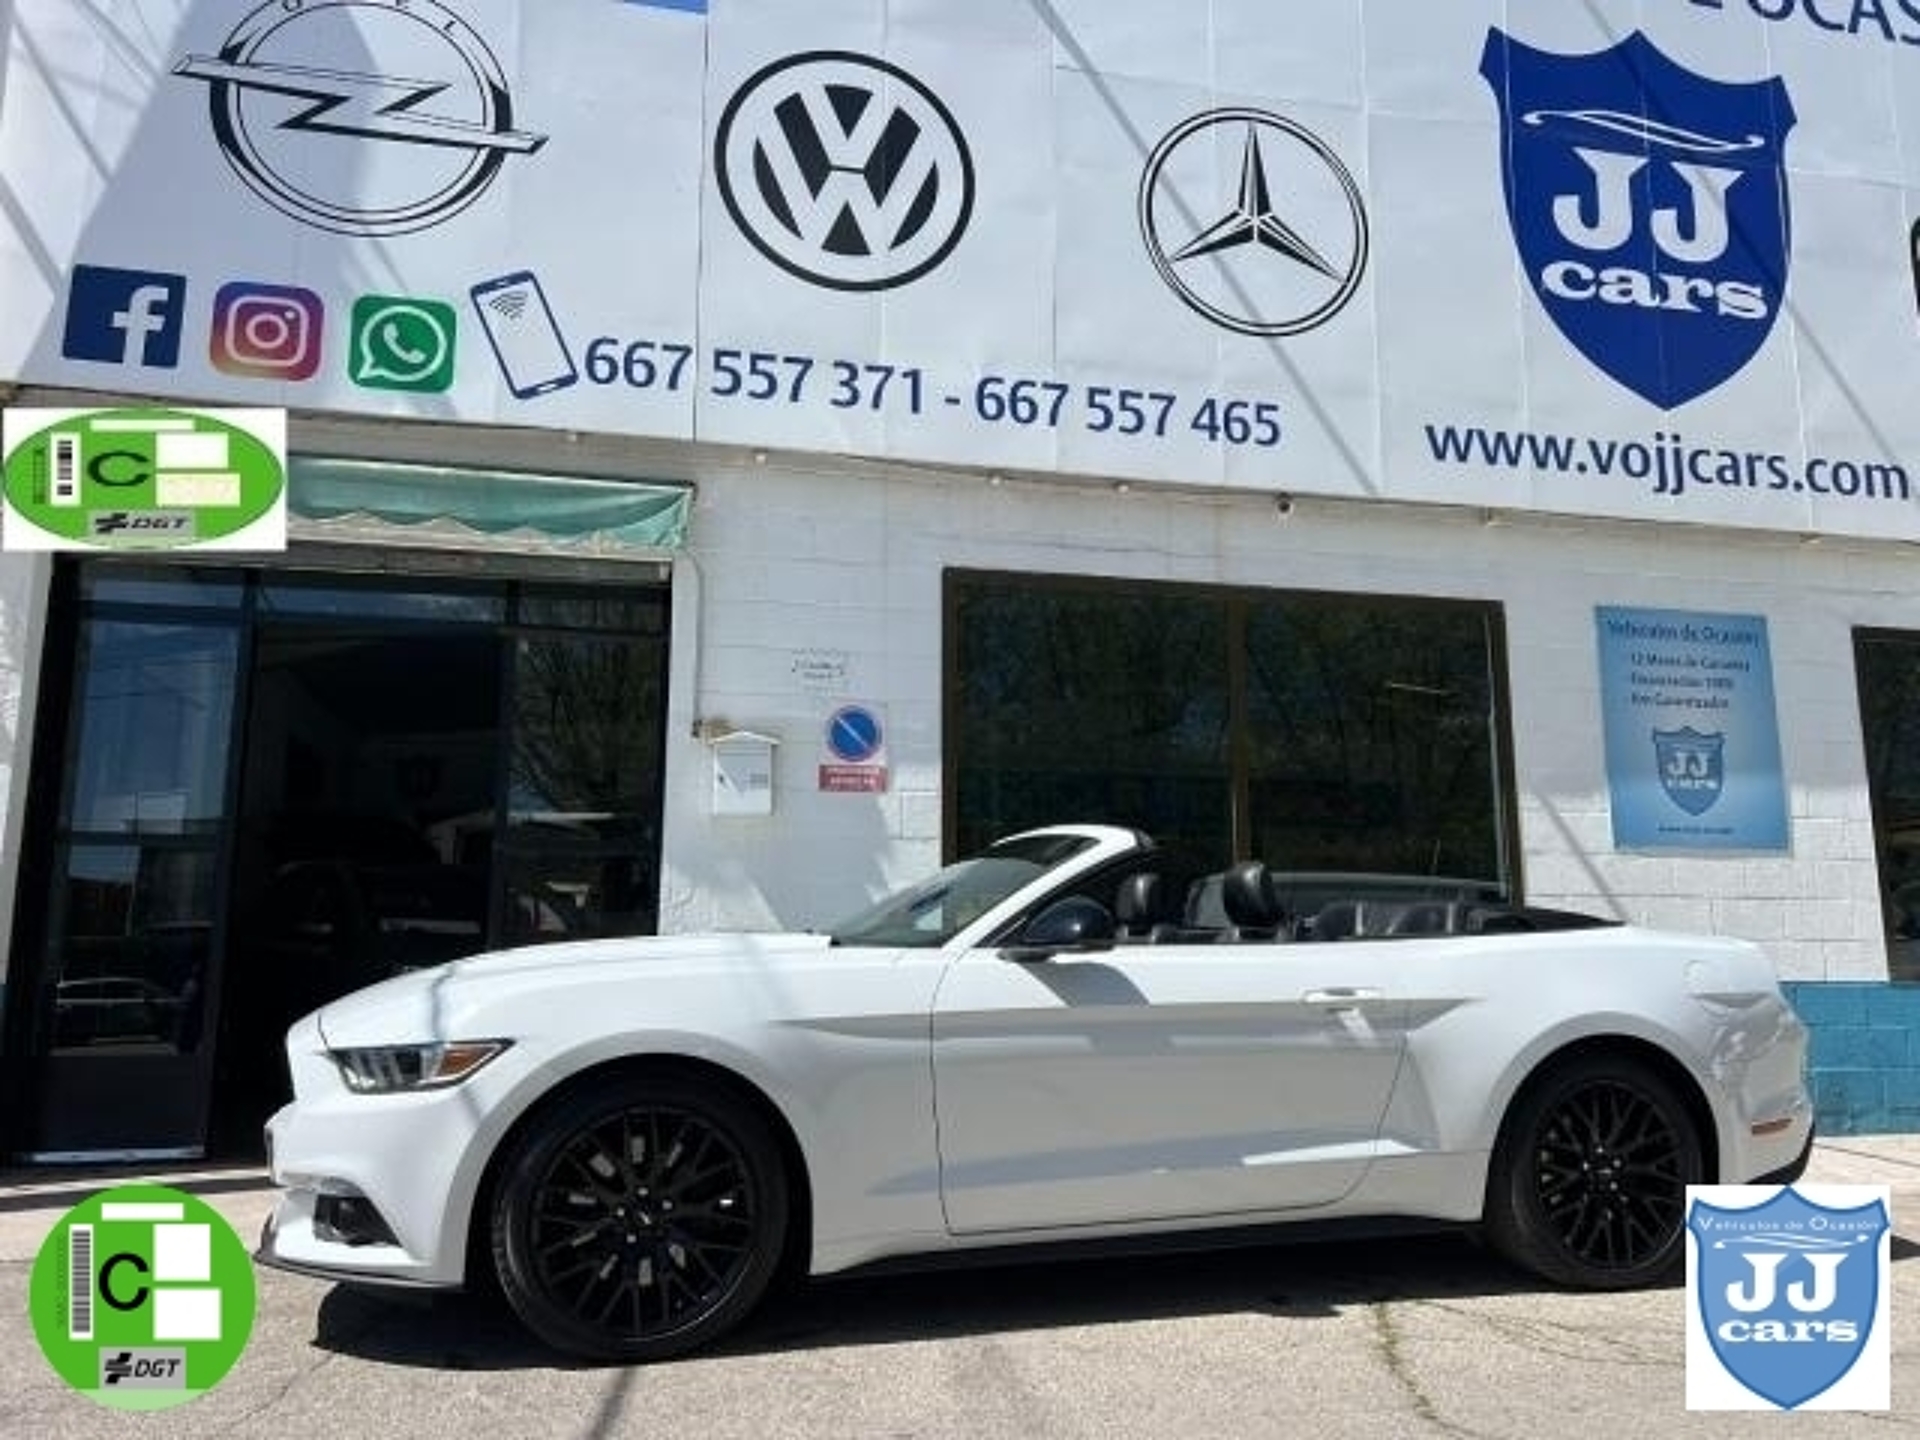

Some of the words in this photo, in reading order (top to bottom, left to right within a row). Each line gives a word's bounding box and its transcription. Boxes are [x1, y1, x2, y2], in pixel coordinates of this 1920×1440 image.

[1553, 146, 1744, 263] JJ
[1541, 260, 1768, 319] cars
[585, 336, 694, 391] 667
[711, 348, 814, 403] 557
[830, 360, 923, 415] 371
[976, 376, 1070, 427] 667
[1087, 387, 1177, 436] 557
[1190, 398, 1281, 446] 465
[1425, 424, 1910, 500] www.vojjcars.com
